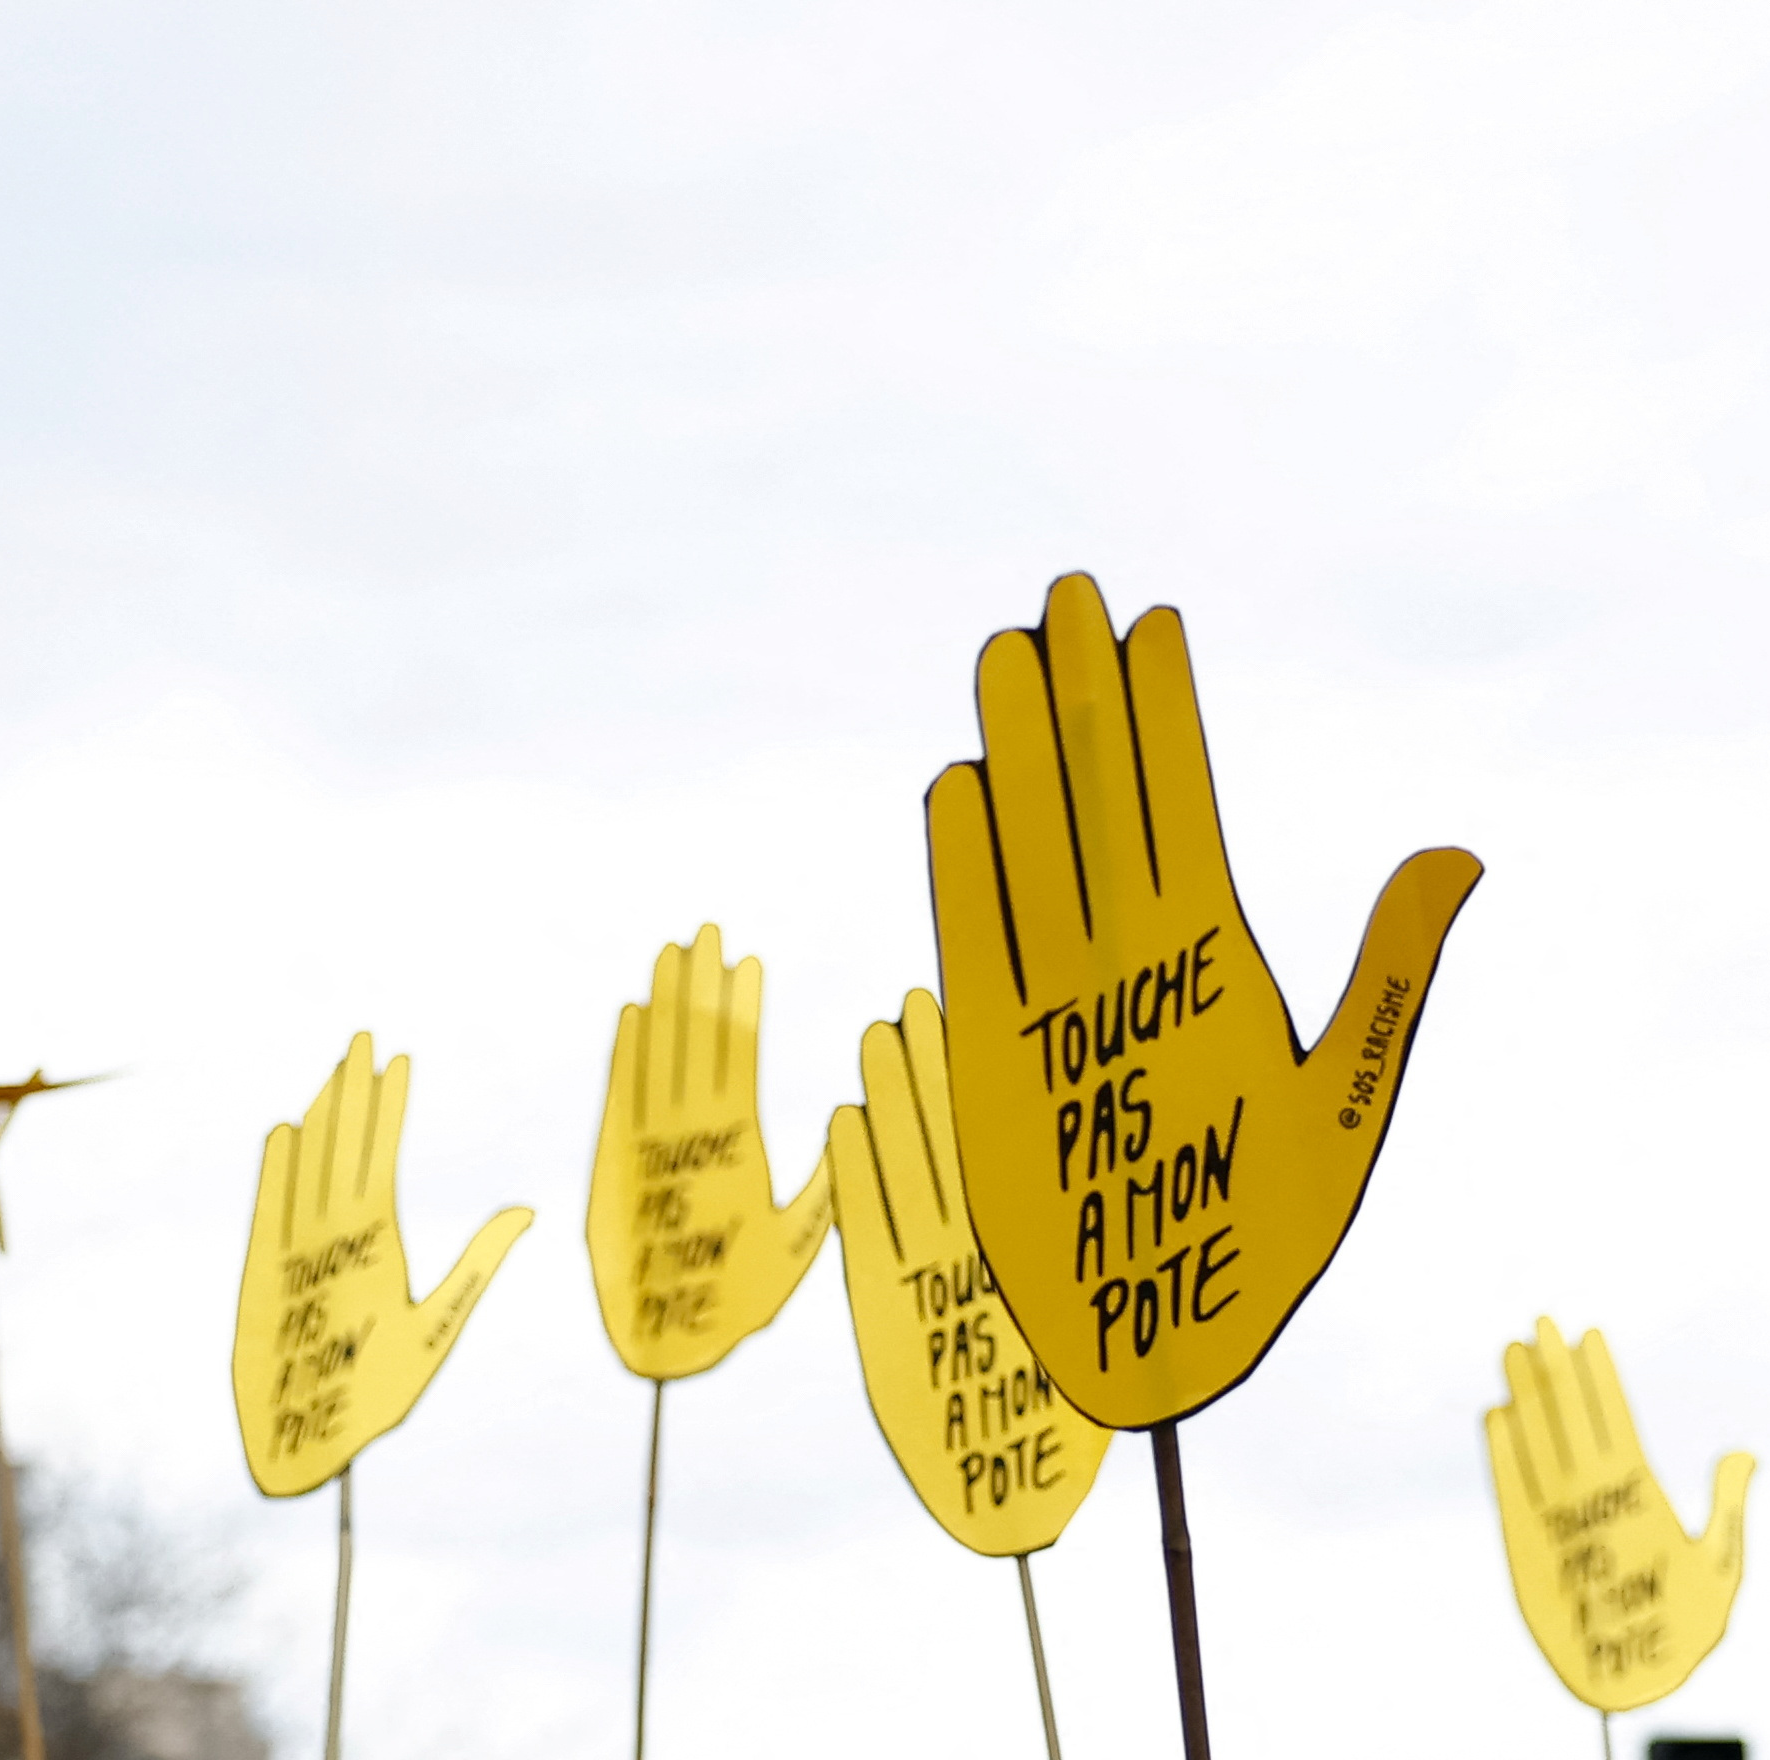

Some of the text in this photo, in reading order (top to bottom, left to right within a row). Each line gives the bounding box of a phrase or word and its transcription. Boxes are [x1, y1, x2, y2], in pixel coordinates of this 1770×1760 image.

[1019, 925, 1225, 1093] TOUCHE
[1338, 975, 1411, 1130] @SOS_RACISME
[1057, 1067, 1152, 1193] PAS
[1076, 1096, 1245, 1283] A MON
[928, 1311, 996, 1390] PAS
[1090, 1224, 1241, 1373] POTE
[945, 1392, 968, 1451] A
[958, 1425, 1067, 1515] POTE
